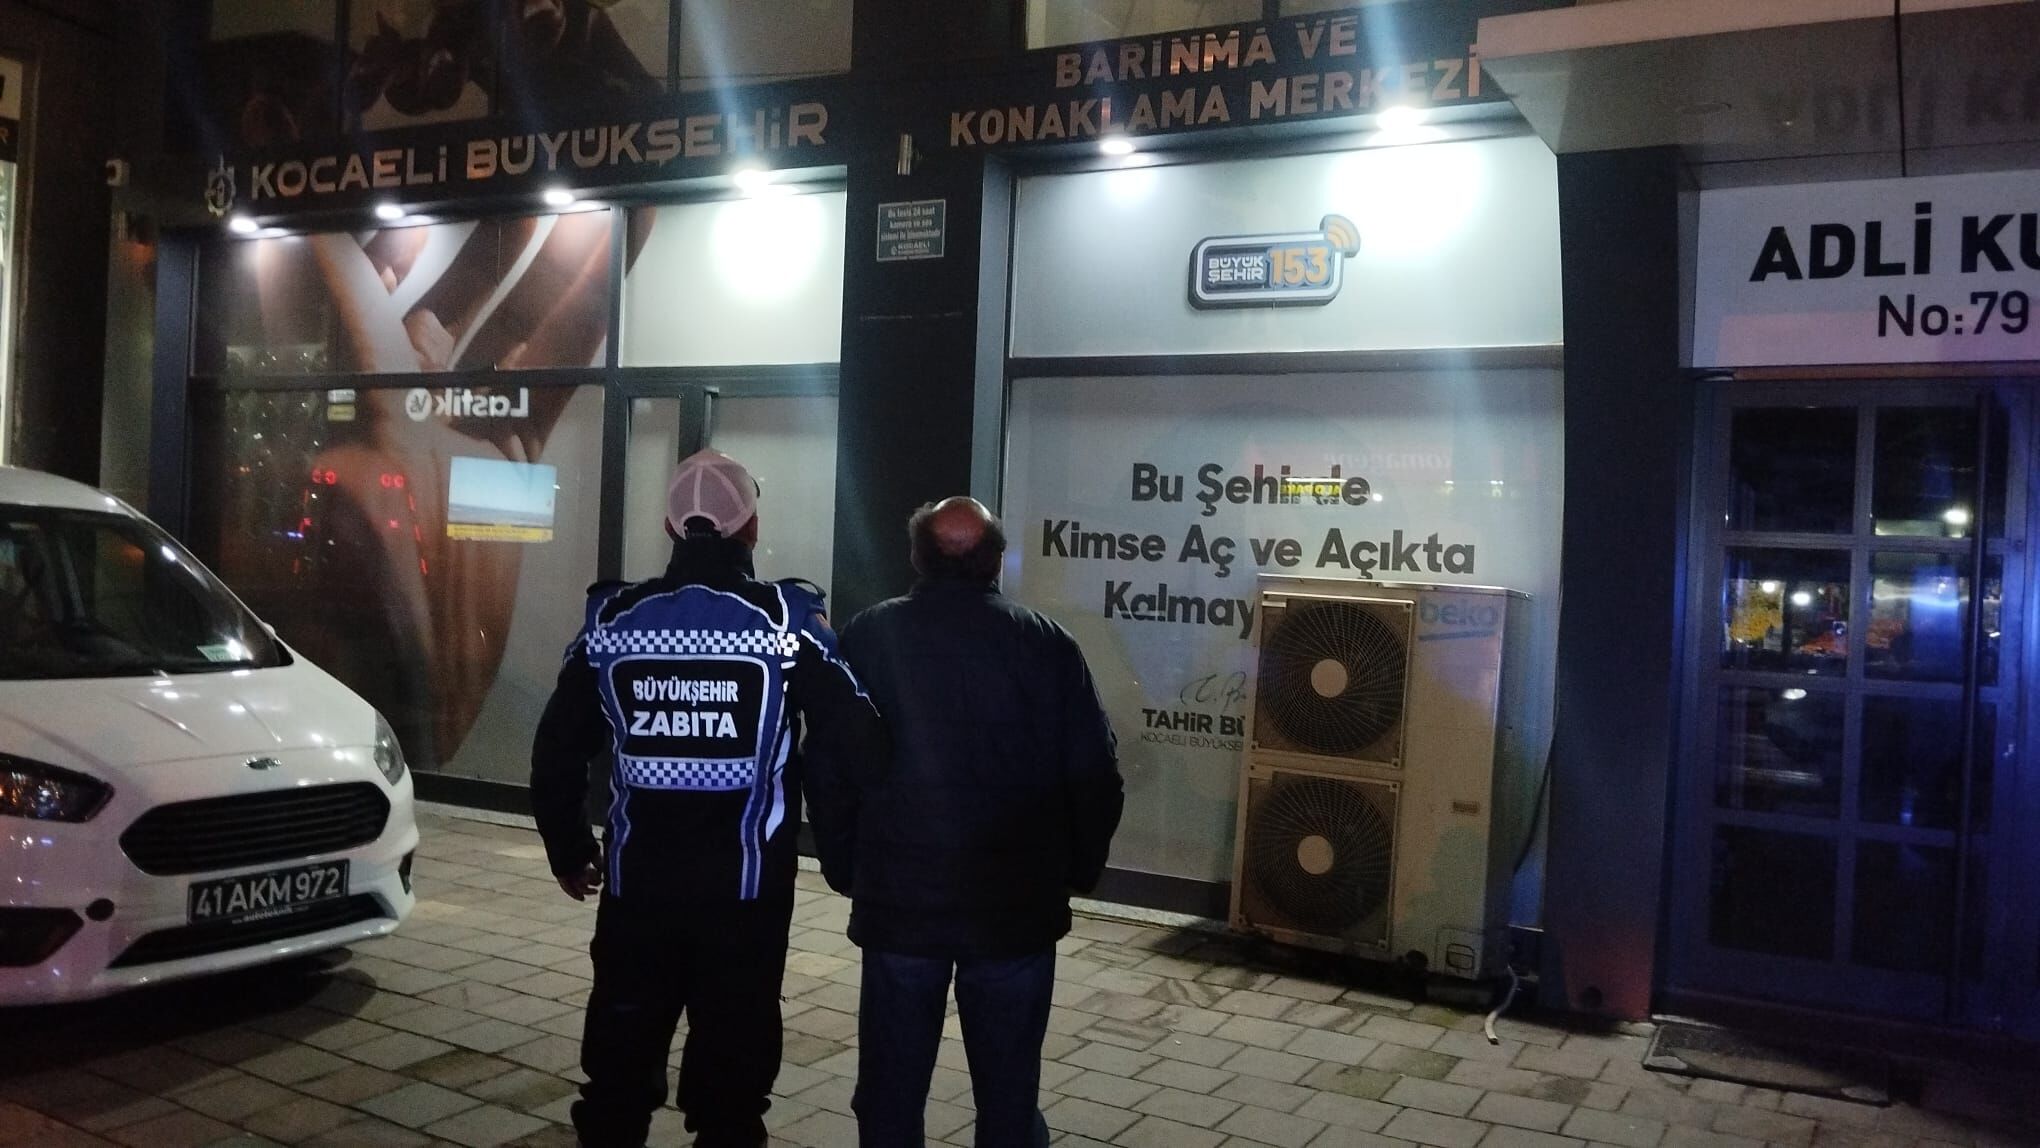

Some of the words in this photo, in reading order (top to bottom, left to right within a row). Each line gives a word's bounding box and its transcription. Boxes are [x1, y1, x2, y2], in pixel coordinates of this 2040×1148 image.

[1056, 28, 1276, 88] BARINMA
[1296, 16, 1359, 60] VE
[950, 85, 1231, 147] KONAKLAMA
[1250, 44, 1481, 119] MERKEZİ
[1208, 255, 1264, 270] BÜYÜK
[1270, 246, 1329, 285] 153
[1749, 202, 1932, 282] ADLİ
[1878, 290, 2030, 337] No:79
[1131, 463, 1183, 502] Bu
[1042, 519, 1167, 562] Kimse
[1178, 524, 1237, 578] Aç
[1249, 538, 1304, 568] ve
[1315, 527, 1476, 580] Açıkta
[630, 711, 738, 738] ZABITA
[196, 887, 223, 917] 41
[226, 875, 292, 913] AKM
[295, 867, 340, 900] 972
